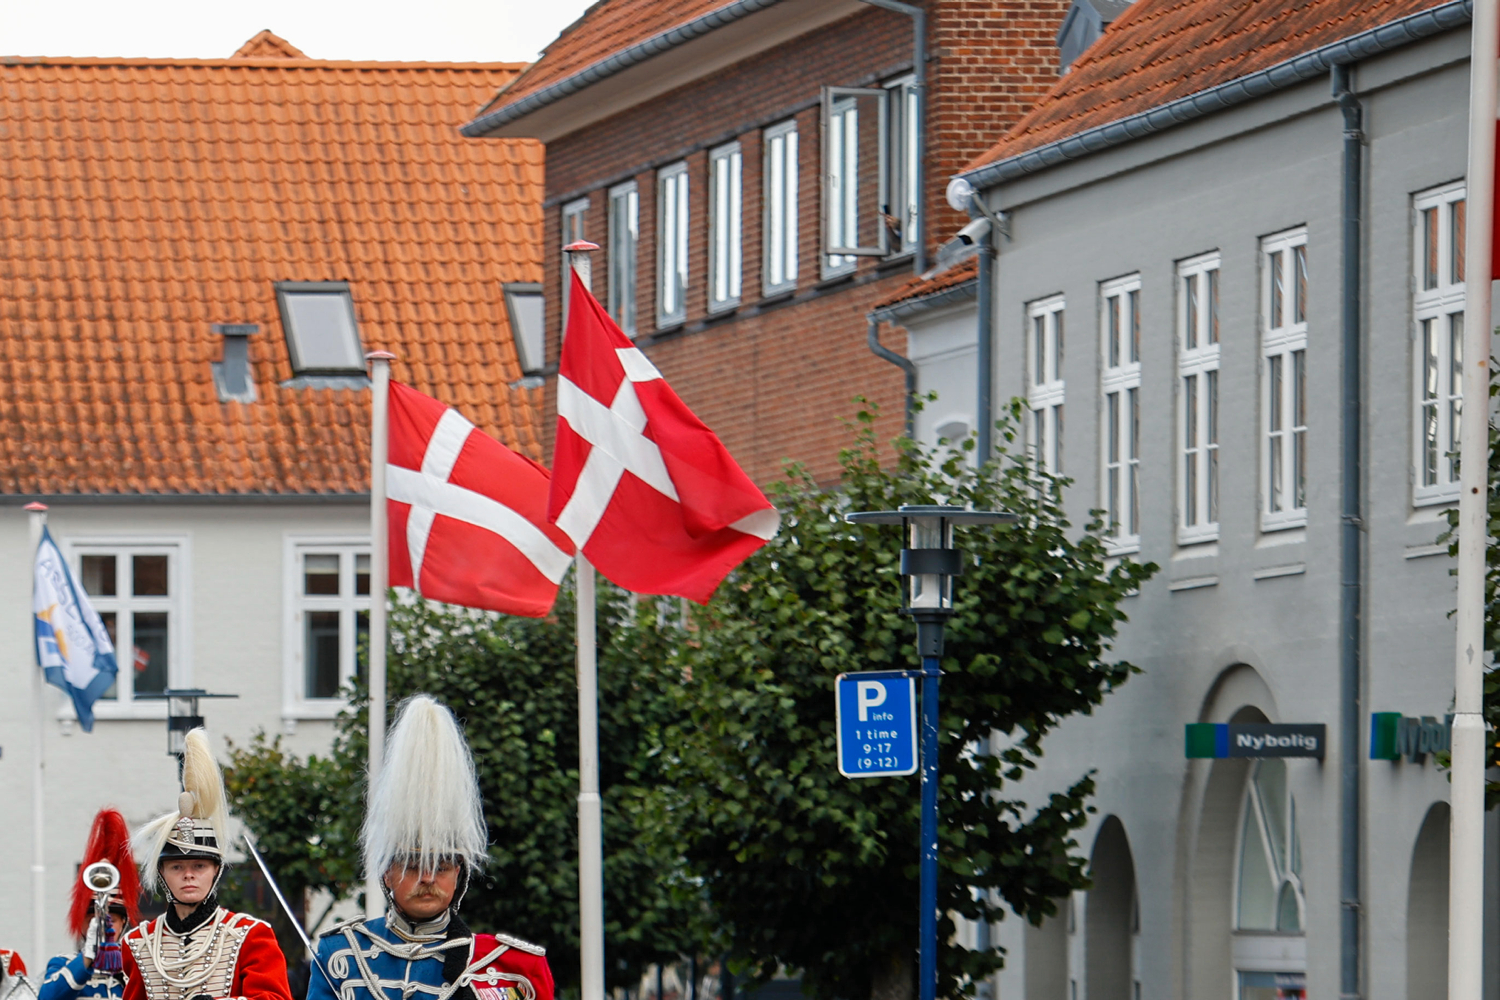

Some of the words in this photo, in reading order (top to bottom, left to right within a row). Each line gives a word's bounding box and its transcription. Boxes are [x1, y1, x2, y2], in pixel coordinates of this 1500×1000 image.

[857, 681, 887, 722] P
[872, 712, 894, 721] info
[855, 730, 861, 740] 1
[866, 729, 898, 739] time
[1236, 732, 1318, 751] Nybolig
[1395, 713, 1455, 764] Nybol
[862, 743, 891, 754] 9-17
[857, 757, 898, 770] (9-12)
